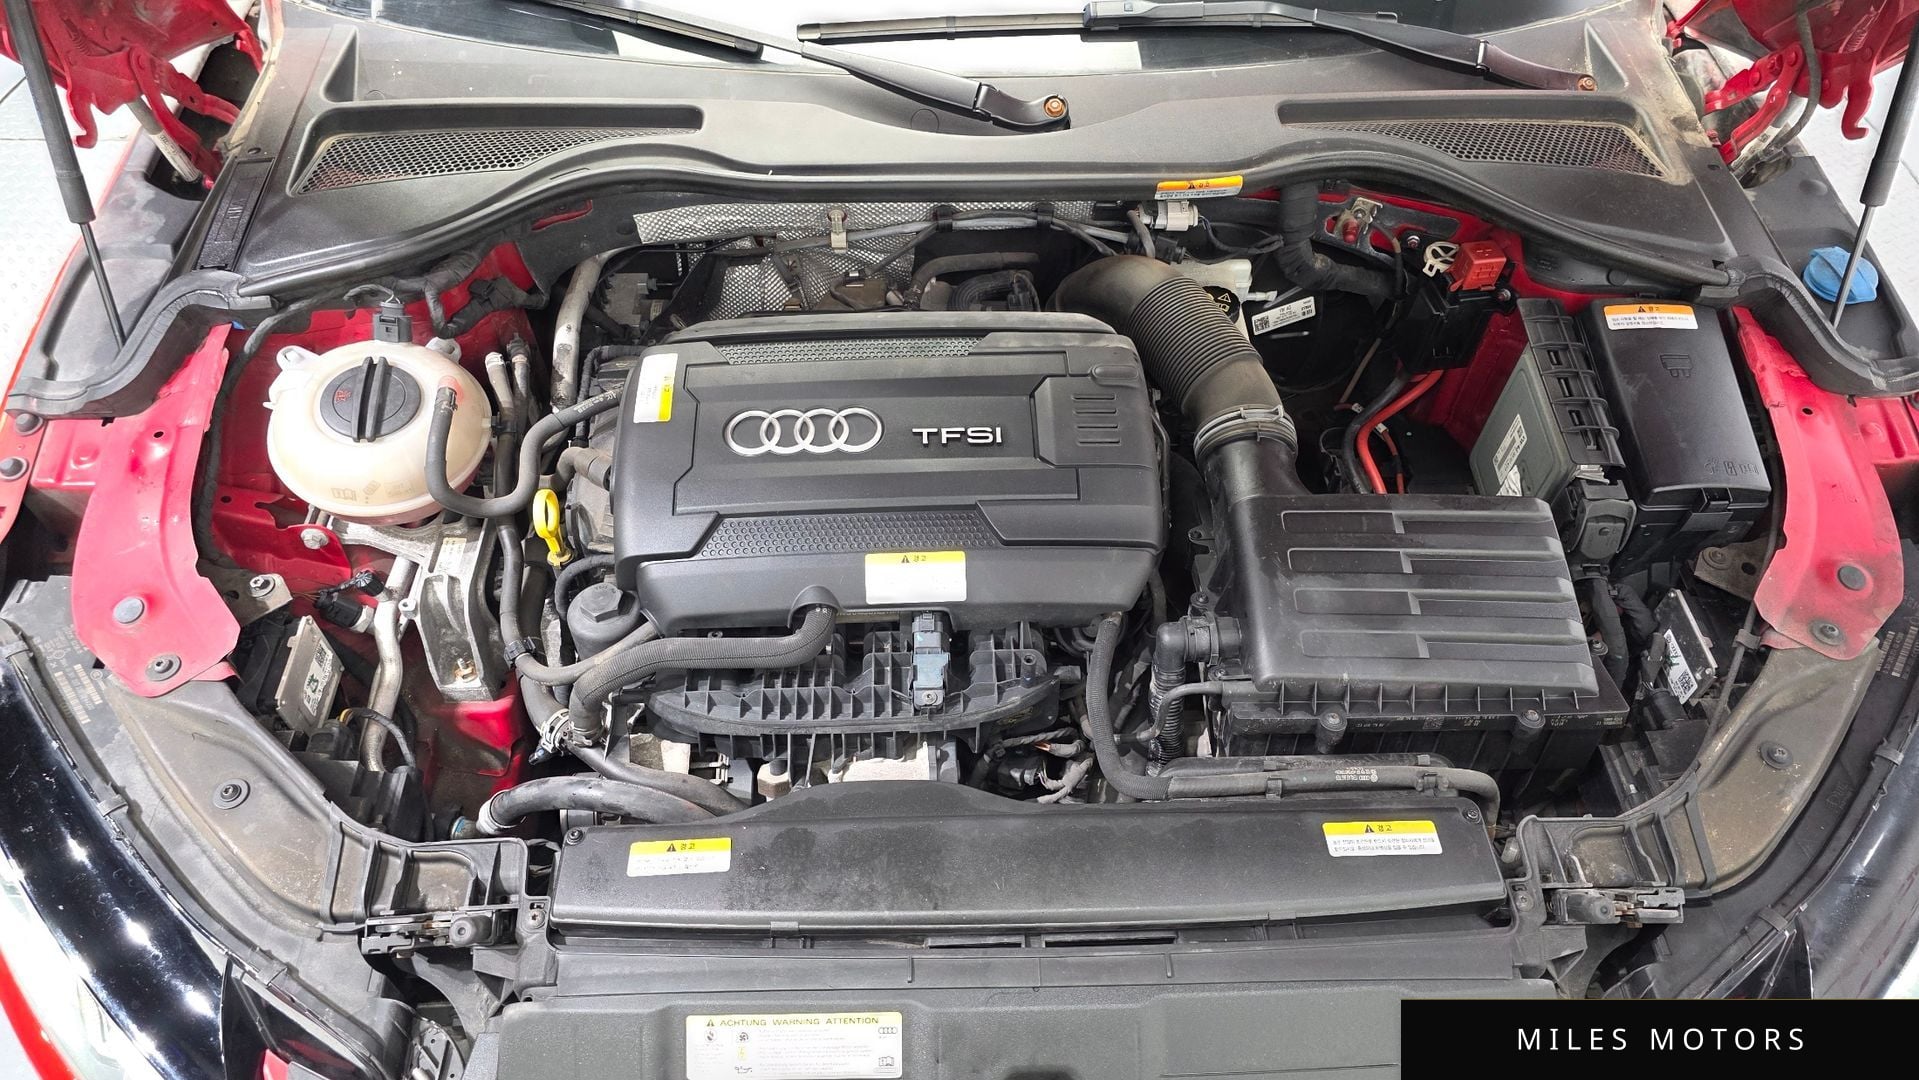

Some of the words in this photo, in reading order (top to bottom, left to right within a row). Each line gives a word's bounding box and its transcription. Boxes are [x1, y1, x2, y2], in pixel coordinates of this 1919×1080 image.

[912, 427, 1002, 444] TFSI
[719, 1019, 767, 1027] ACHTUNG
[772, 1018, 820, 1026] WARNING
[826, 1017, 879, 1025] ATTENTION
